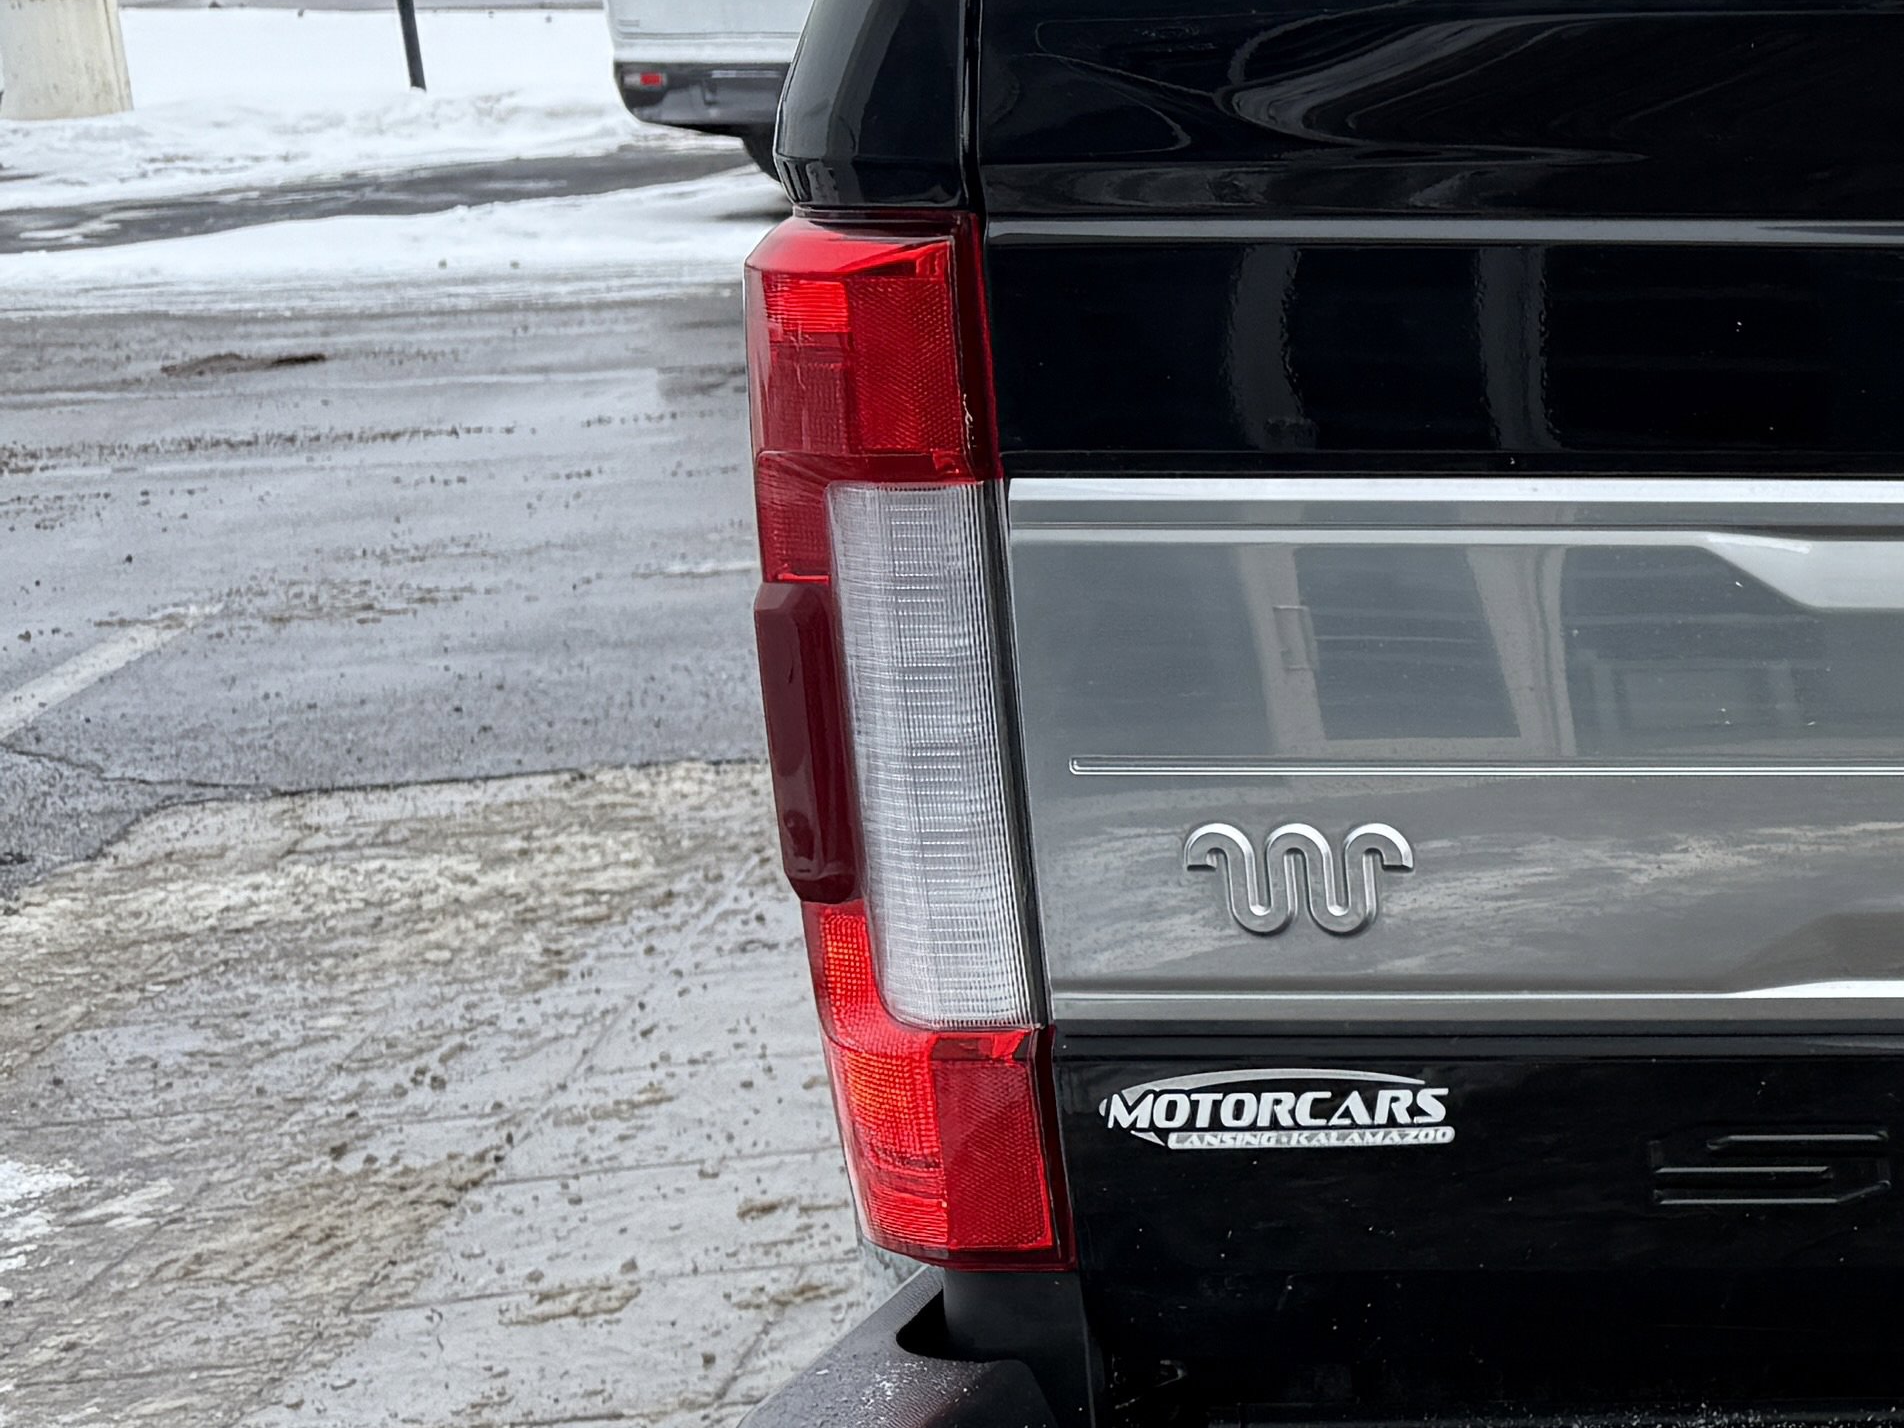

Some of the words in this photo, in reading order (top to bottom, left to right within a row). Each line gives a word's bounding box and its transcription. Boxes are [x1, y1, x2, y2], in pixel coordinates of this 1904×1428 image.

[1107, 1088, 1449, 1129] MOTORCARS
[1170, 1132, 1280, 1147] LANSING
[1289, 1128, 1452, 1146] KALAMAZOO
